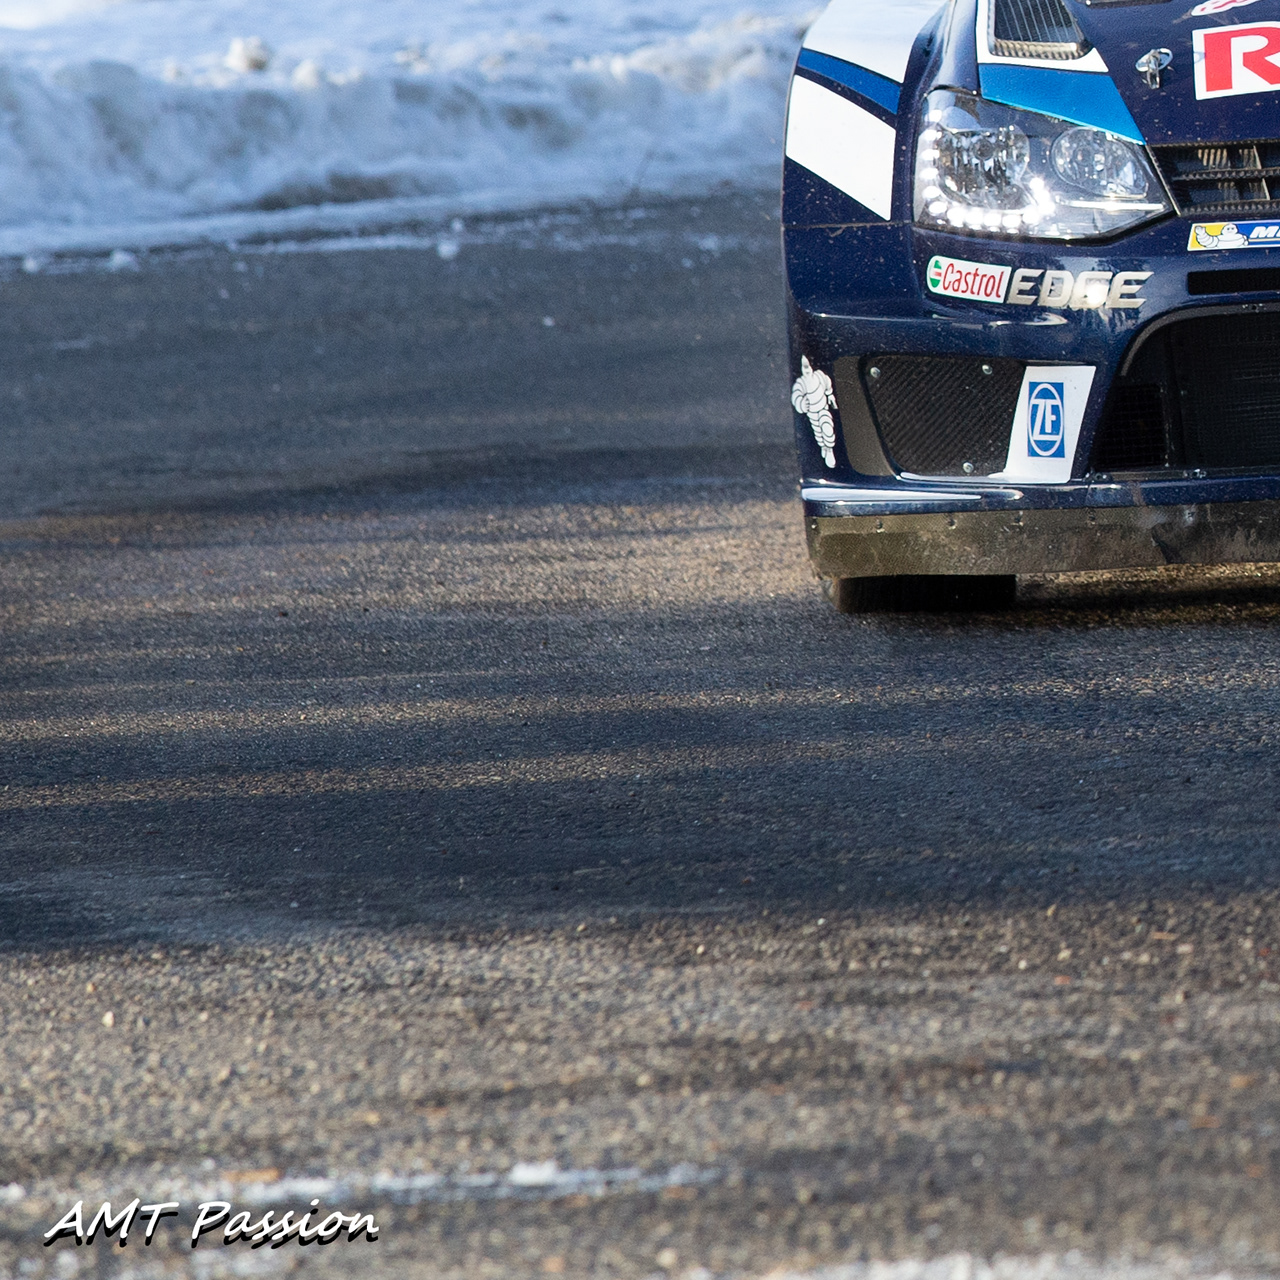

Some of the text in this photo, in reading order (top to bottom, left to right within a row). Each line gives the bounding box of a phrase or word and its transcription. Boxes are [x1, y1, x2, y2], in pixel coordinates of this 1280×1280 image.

[941, 262, 1154, 310] Castrol EDGE
[1031, 398, 1061, 441] ZF
